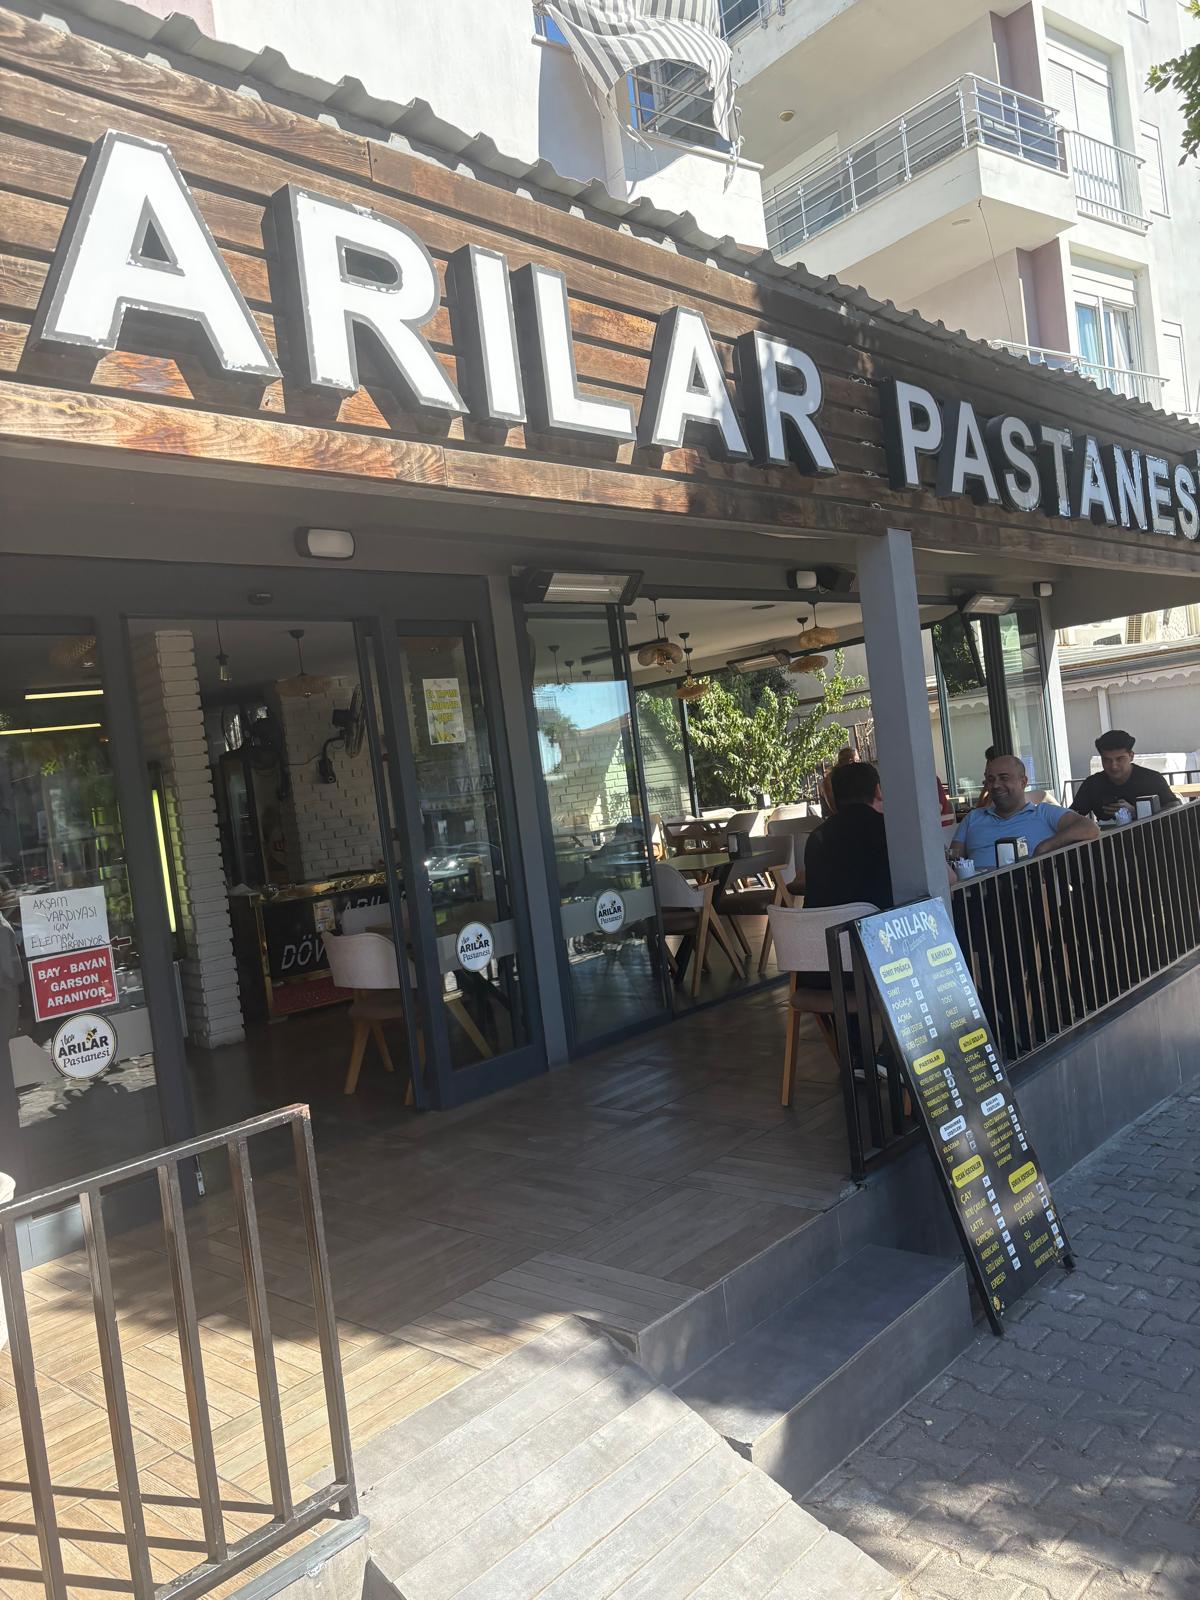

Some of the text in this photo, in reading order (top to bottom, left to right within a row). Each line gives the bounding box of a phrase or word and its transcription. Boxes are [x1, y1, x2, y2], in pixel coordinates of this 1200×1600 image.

[36, 128, 1200, 541] ARILAR PASTANES
[33, 896, 68, 912] AKŞAM
[599, 905, 622, 918] ARILAR
[885, 911, 931, 941] ARILAR
[31, 932, 74, 949] ELEMAN
[61, 935, 108, 951] ARANIYOR
[460, 939, 490, 954] ARILAR
[38, 966, 60, 981] BAY
[70, 956, 107, 973] BAYAN
[51, 973, 99, 992] GARSON
[47, 986, 107, 1008] ARANIYOR
[58, 1035, 109, 1059] ARILAR
[63, 1047, 110, 1068] Pastanesi
[960, 1190, 973, 1205] ÇAY
[971, 1217, 985, 1232] LATTE
